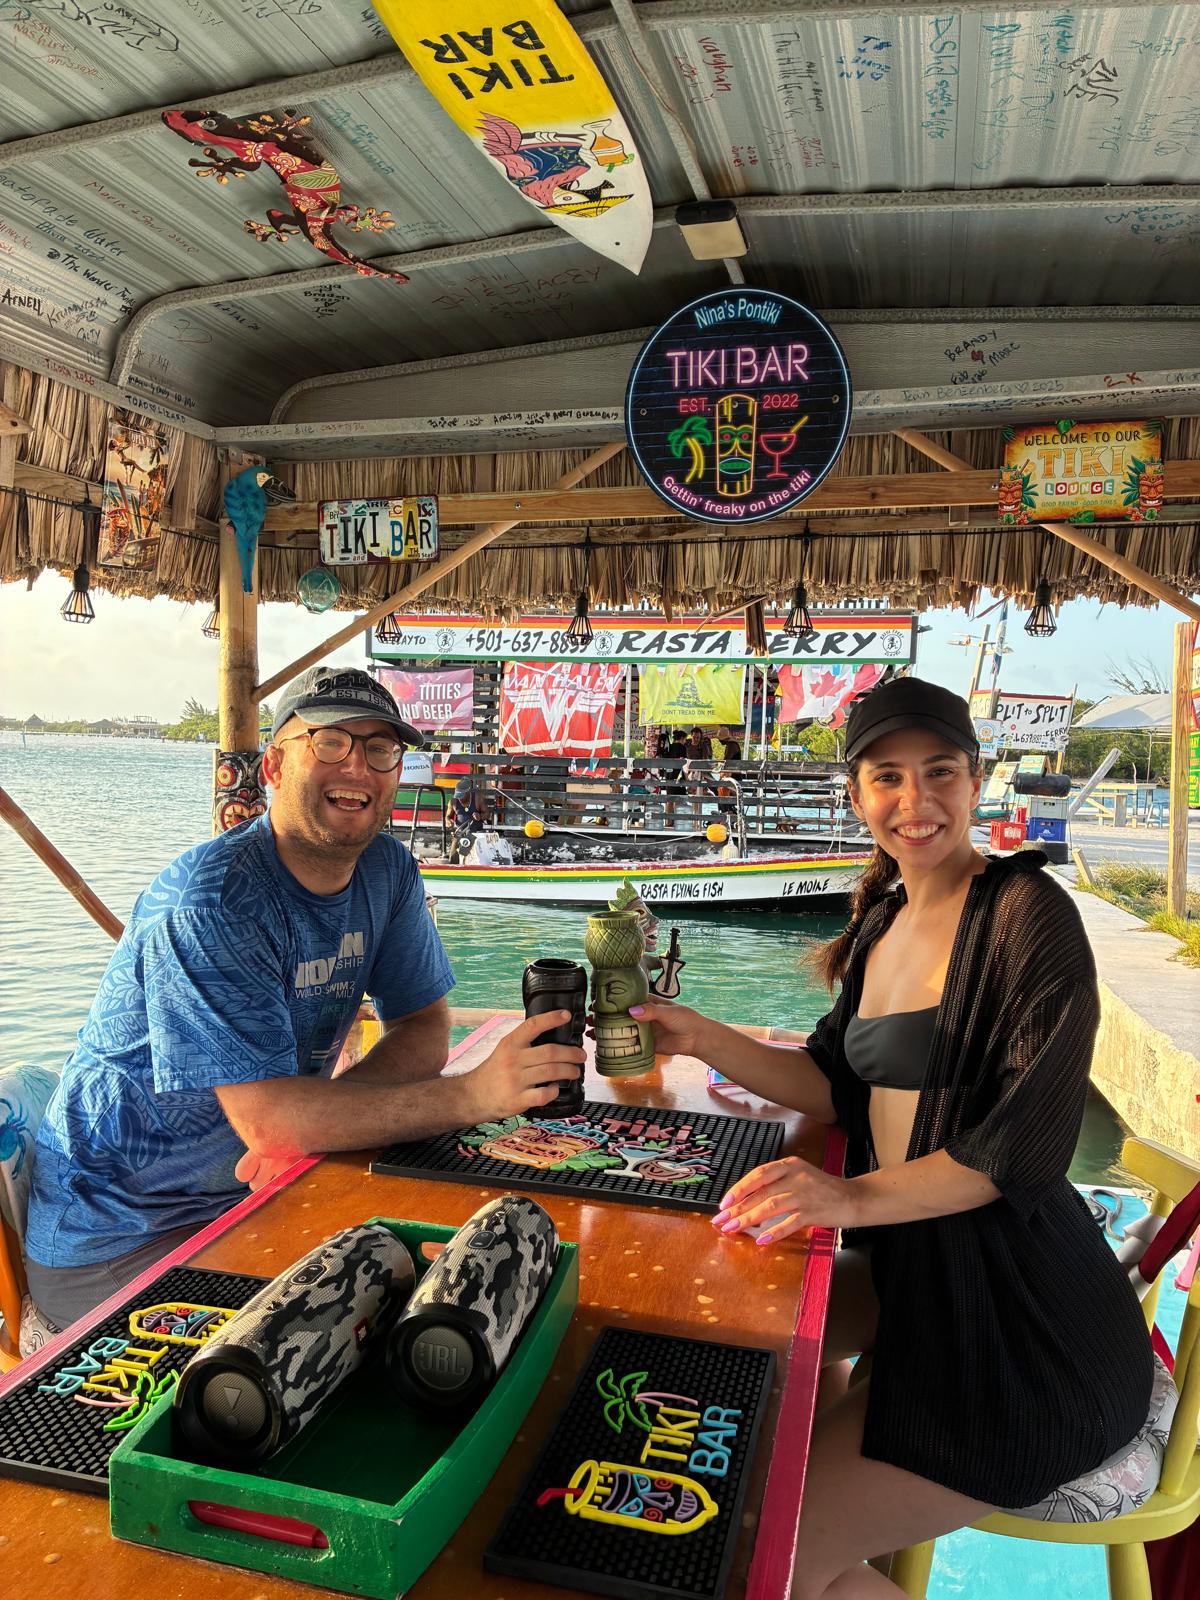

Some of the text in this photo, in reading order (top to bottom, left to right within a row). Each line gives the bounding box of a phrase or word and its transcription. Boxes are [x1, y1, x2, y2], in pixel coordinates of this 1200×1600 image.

[419, 19, 545, 64] BAR
[448, 54, 575, 100] TIKI
[694, 297, 783, 329] Nina's Pontiki
[666, 343, 809, 387] TIKI BAR
[679, 393, 799, 414] EST. 2022
[1024, 430, 1141, 446] WELCOME TO OUR
[1037, 446, 1126, 479] TIKI
[704, 500, 746, 517] freaky
[749, 502, 766, 513] on
[768, 483, 791, 507] the
[790, 470, 812, 491] tiki
[1045, 479, 1114, 496] LOUNGE
[326, 510, 432, 559] TIKI BAR
[615, 629, 733, 655] RASTA
[420, 683, 461, 700] TITTIES
[423, 704, 453, 720] BEER
[1030, 703, 1067, 725] SPLIT
[640, 881, 724, 899] RASTA FLYING FISH
[782, 882, 793, 896] LE
[640, 1406, 701, 1464] TIKI
[689, 1405, 742, 1478] BAR
